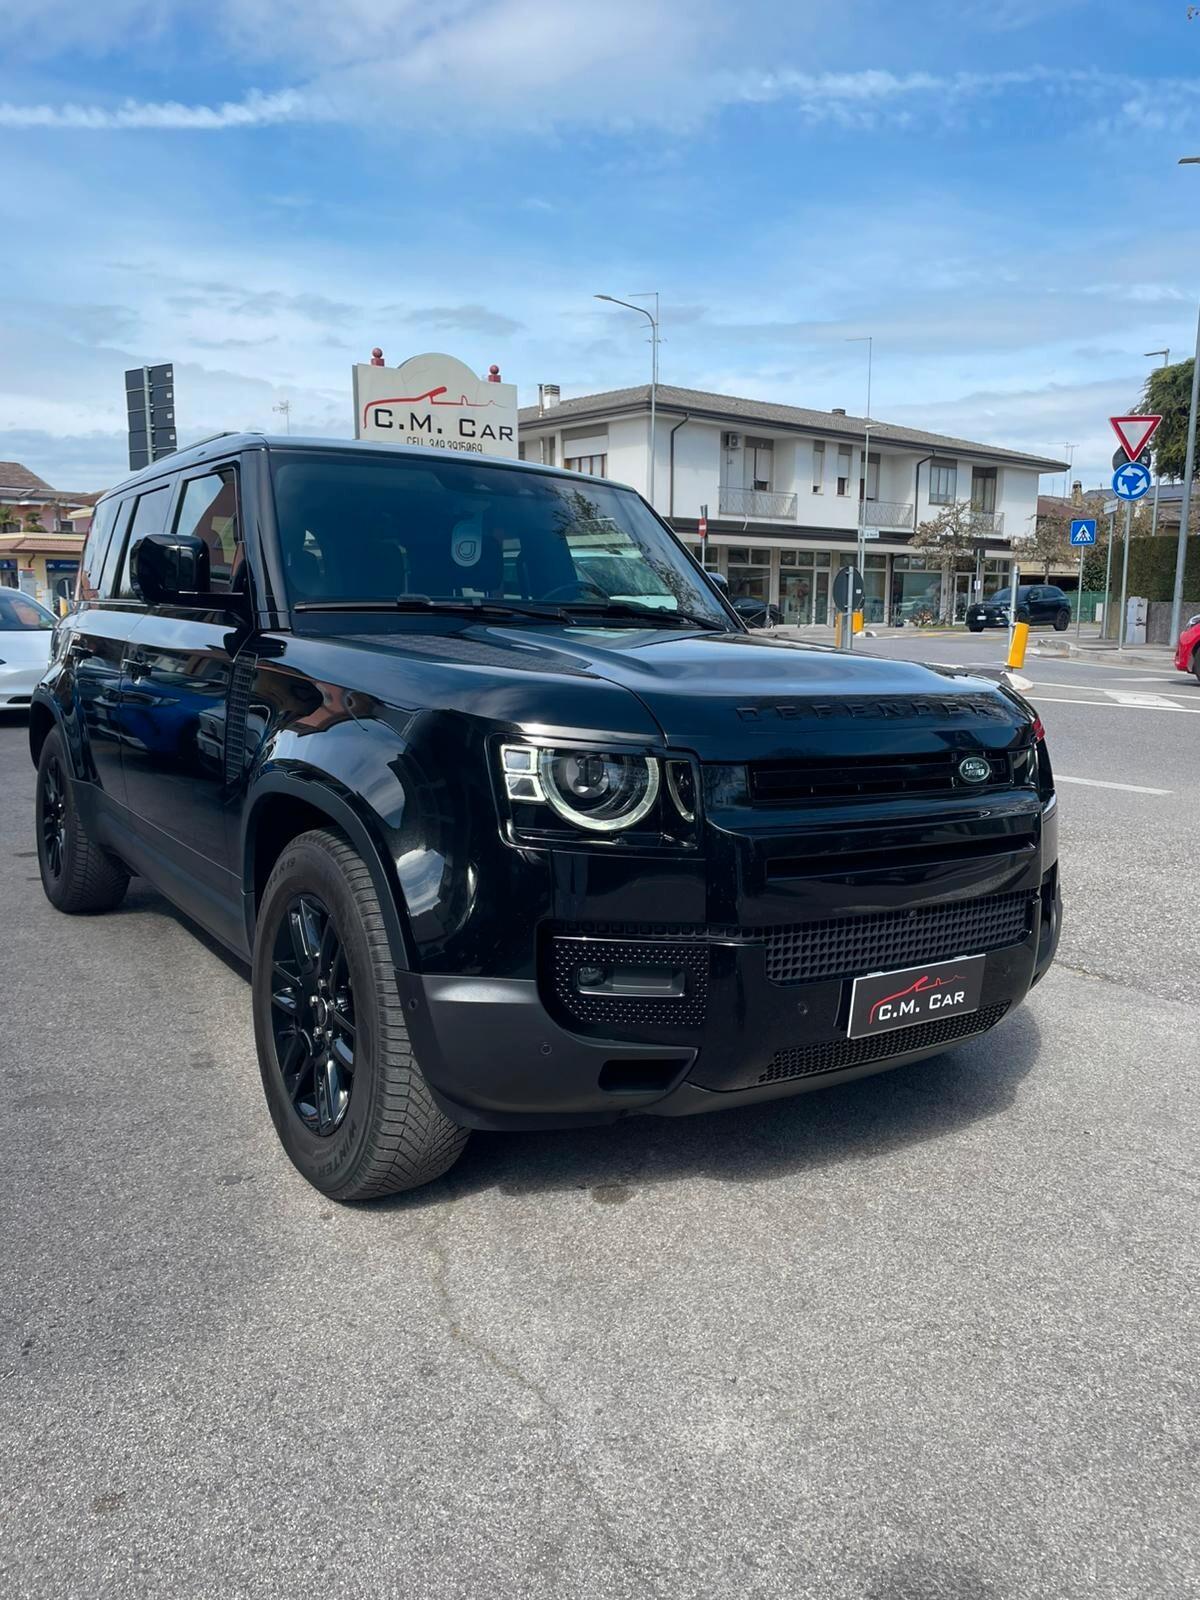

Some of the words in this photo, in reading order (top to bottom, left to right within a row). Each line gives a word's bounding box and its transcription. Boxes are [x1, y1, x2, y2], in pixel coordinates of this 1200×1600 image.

[374, 408, 443, 434] C.M.
[735, 702, 996, 722] DEFENDER
[878, 999, 920, 1021] C.M.
[318, 1119, 358, 1178] WINTER
